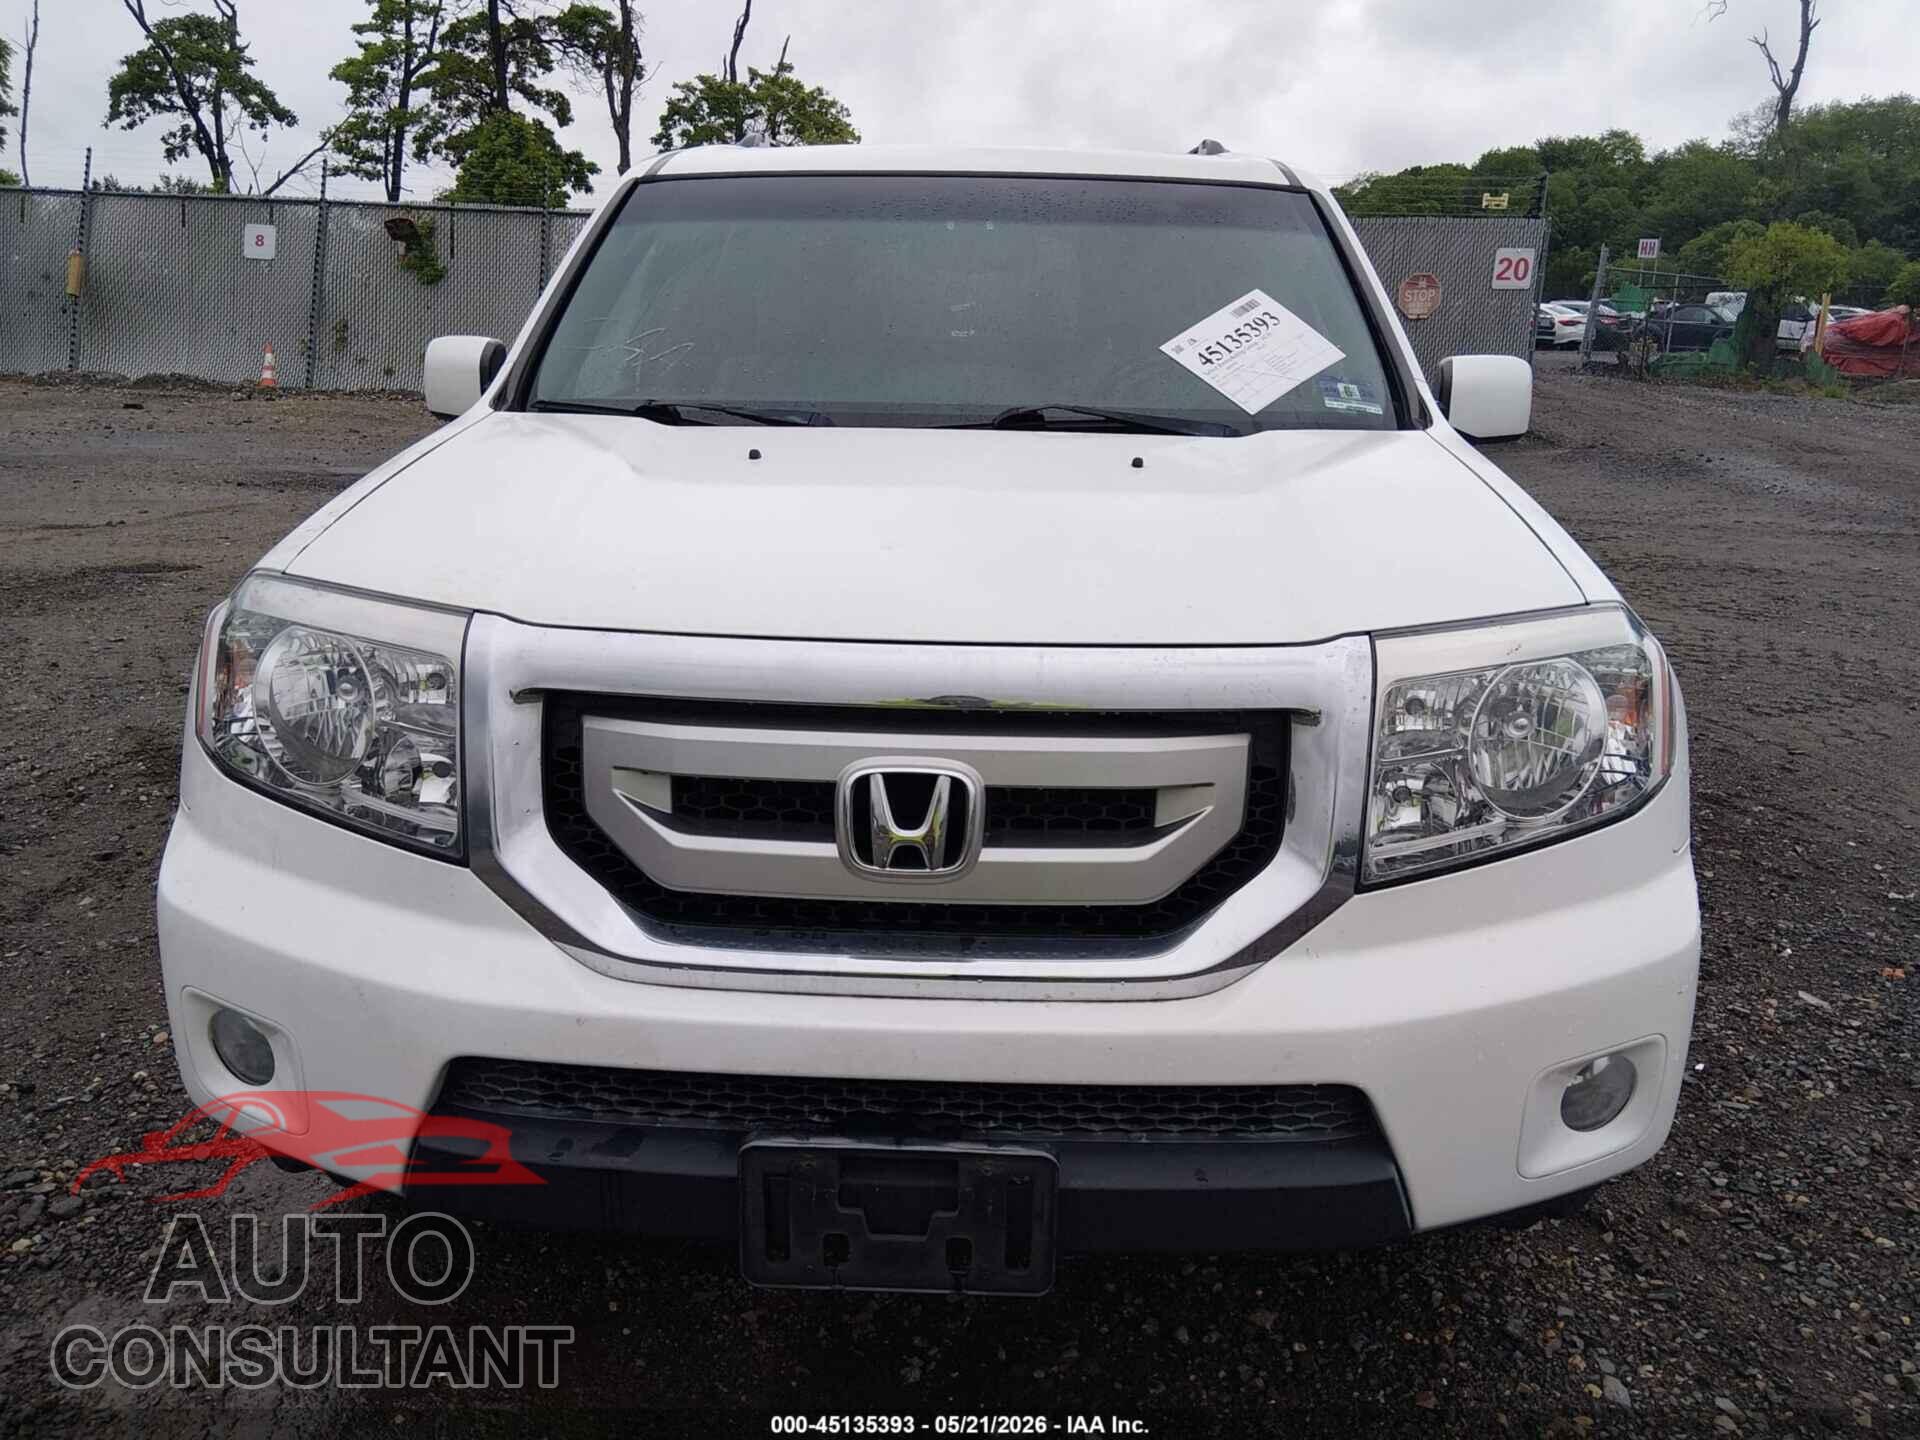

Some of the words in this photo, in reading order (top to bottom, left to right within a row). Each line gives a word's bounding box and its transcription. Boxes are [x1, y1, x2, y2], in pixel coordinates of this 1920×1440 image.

[255, 234, 265, 247] 8
[1495, 257, 1530, 282] 20
[1404, 288, 1436, 303] STOP
[1198, 311, 1281, 366] 45135393
